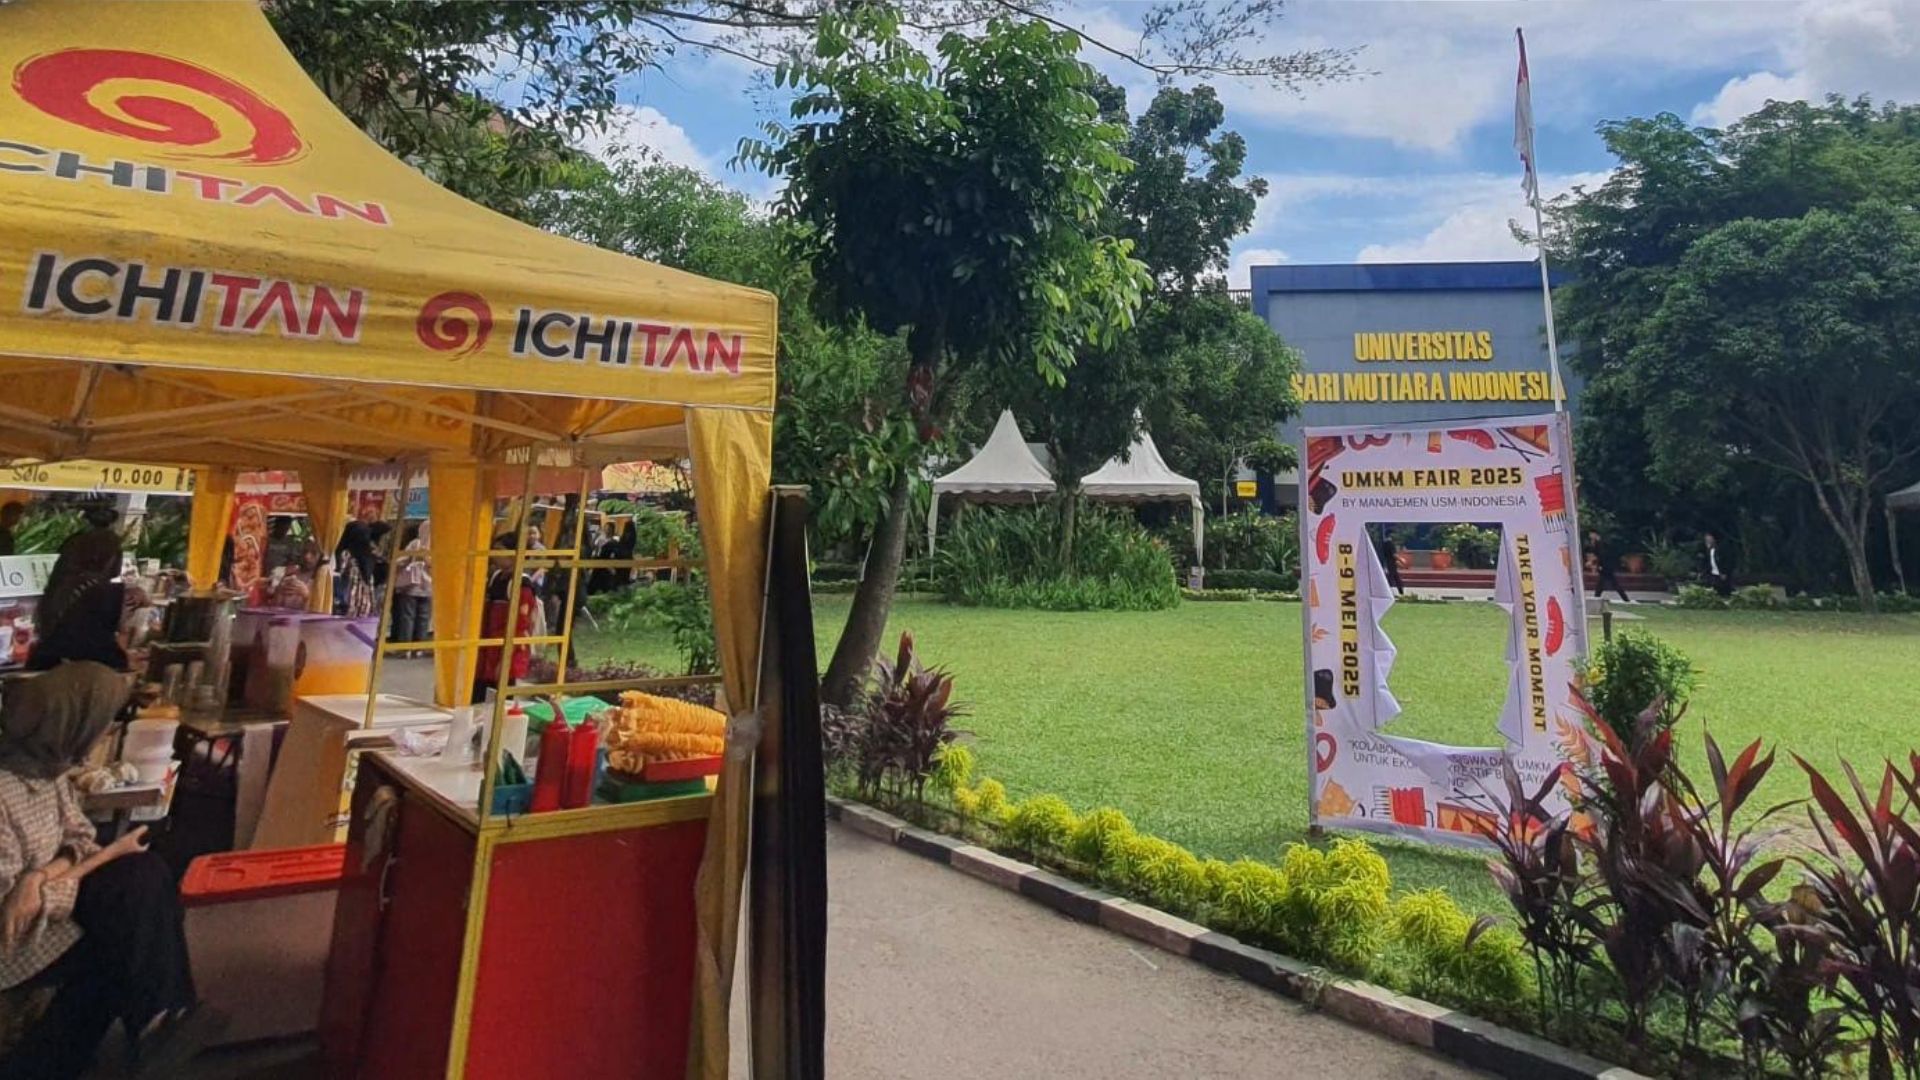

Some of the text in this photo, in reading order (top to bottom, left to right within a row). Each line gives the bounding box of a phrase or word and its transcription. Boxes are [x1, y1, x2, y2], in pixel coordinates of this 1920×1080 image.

[0, 142, 388, 225] CHITAN
[27, 253, 364, 338] ICHITAN
[513, 309, 742, 373] ICHITAN
[1354, 331, 1492, 361] UNIVERSITAS
[1290, 371, 1340, 401] SARI
[1343, 371, 1445, 401] MUTIARA
[101, 467, 163, 485] 10.000
[1341, 467, 1522, 488] UMKM FAIR 2025
[1342, 497, 1355, 508] BY
[1359, 496, 1428, 508] MANAJEMEN
[1338, 543, 1360, 696] 8-9 MEI 2025
[1516, 535, 1547, 732] TAKE YOUR MOMENT
[1353, 752, 1388, 766] UNTUK
